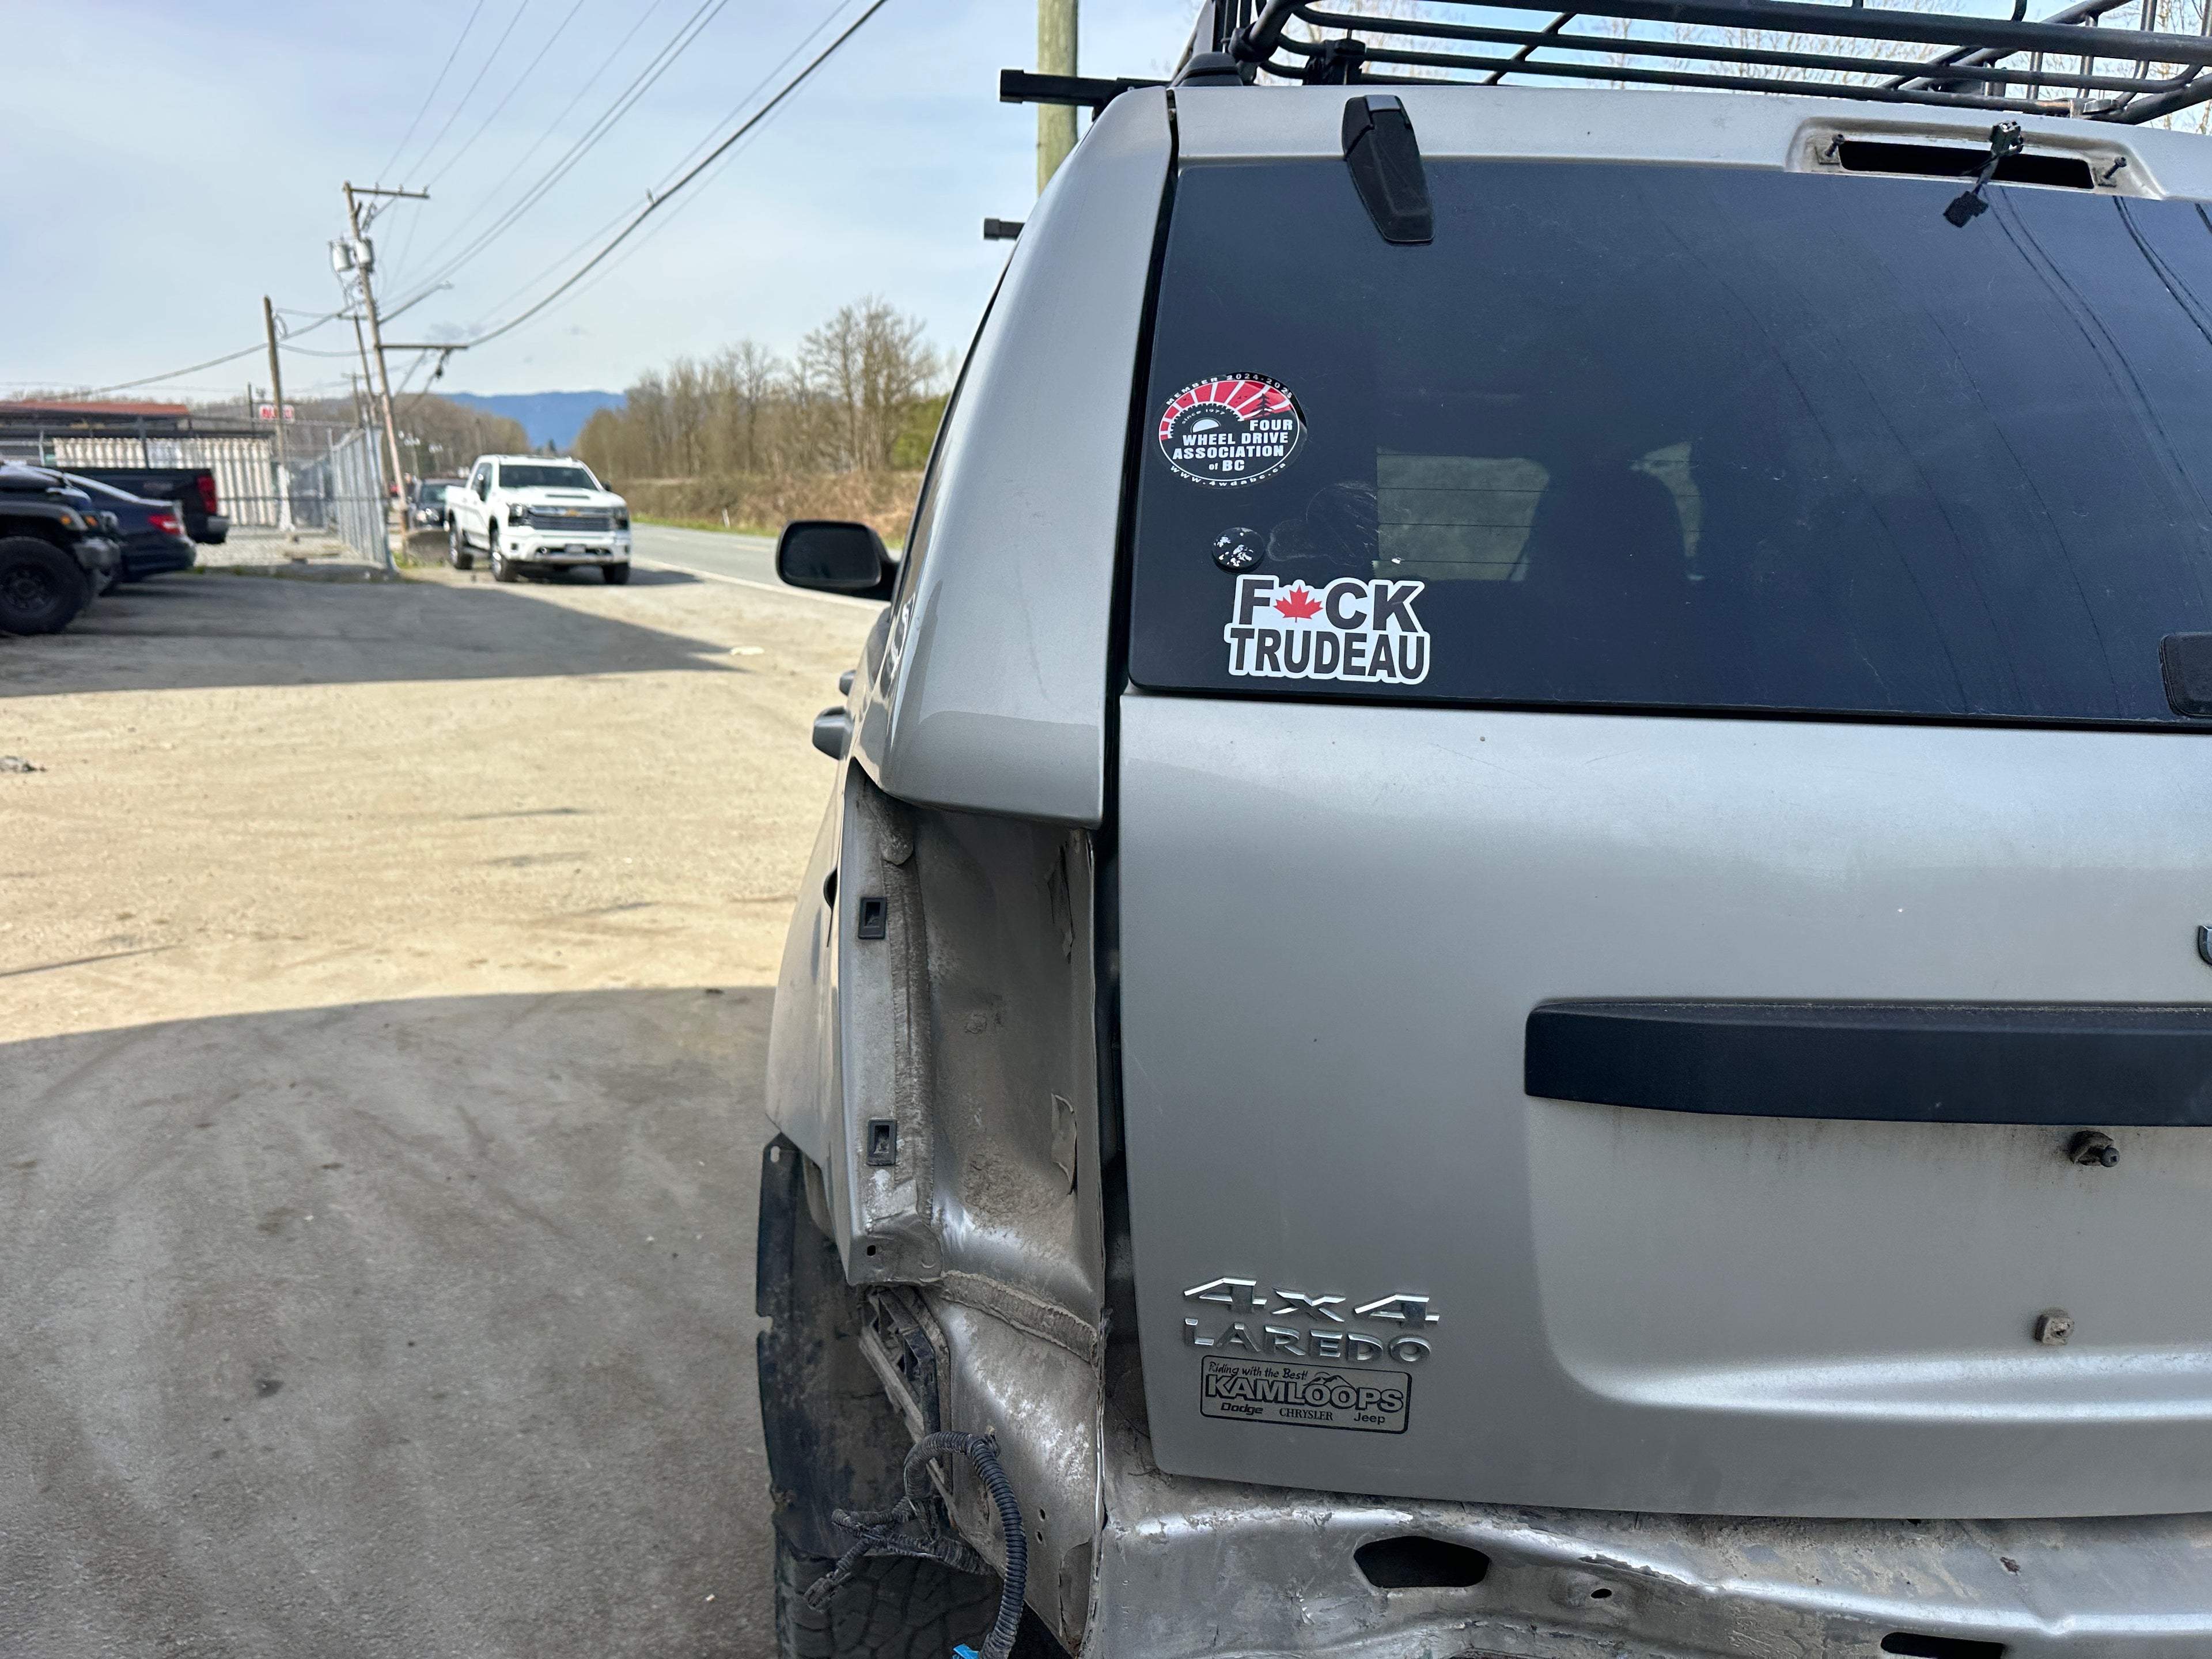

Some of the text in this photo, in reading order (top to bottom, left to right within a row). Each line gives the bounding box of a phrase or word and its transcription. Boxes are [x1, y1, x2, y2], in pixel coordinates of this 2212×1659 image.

[1166, 377, 1218, 405] MEMBER
[1182, 411, 1202, 424] since
[1249, 419, 1293, 431] FOUR
[1183, 432, 1289, 446] WHEEL DRIVE
[1172, 445, 1284, 460] ASSOCIATION
[1171, 463, 1286, 486] www.4wdabc.ca
[1222, 460, 1245, 471] BC
[1230, 627, 1425, 680] TRUDEAU
[1184, 1317, 1432, 1362] LAREDO
[1209, 1362, 1308, 1380] Riding with the Best!
[1206, 1374, 1404, 1413] KAMLOOPS
[1221, 1402, 1385, 1425] Dodge CHRYSLER Jeep
